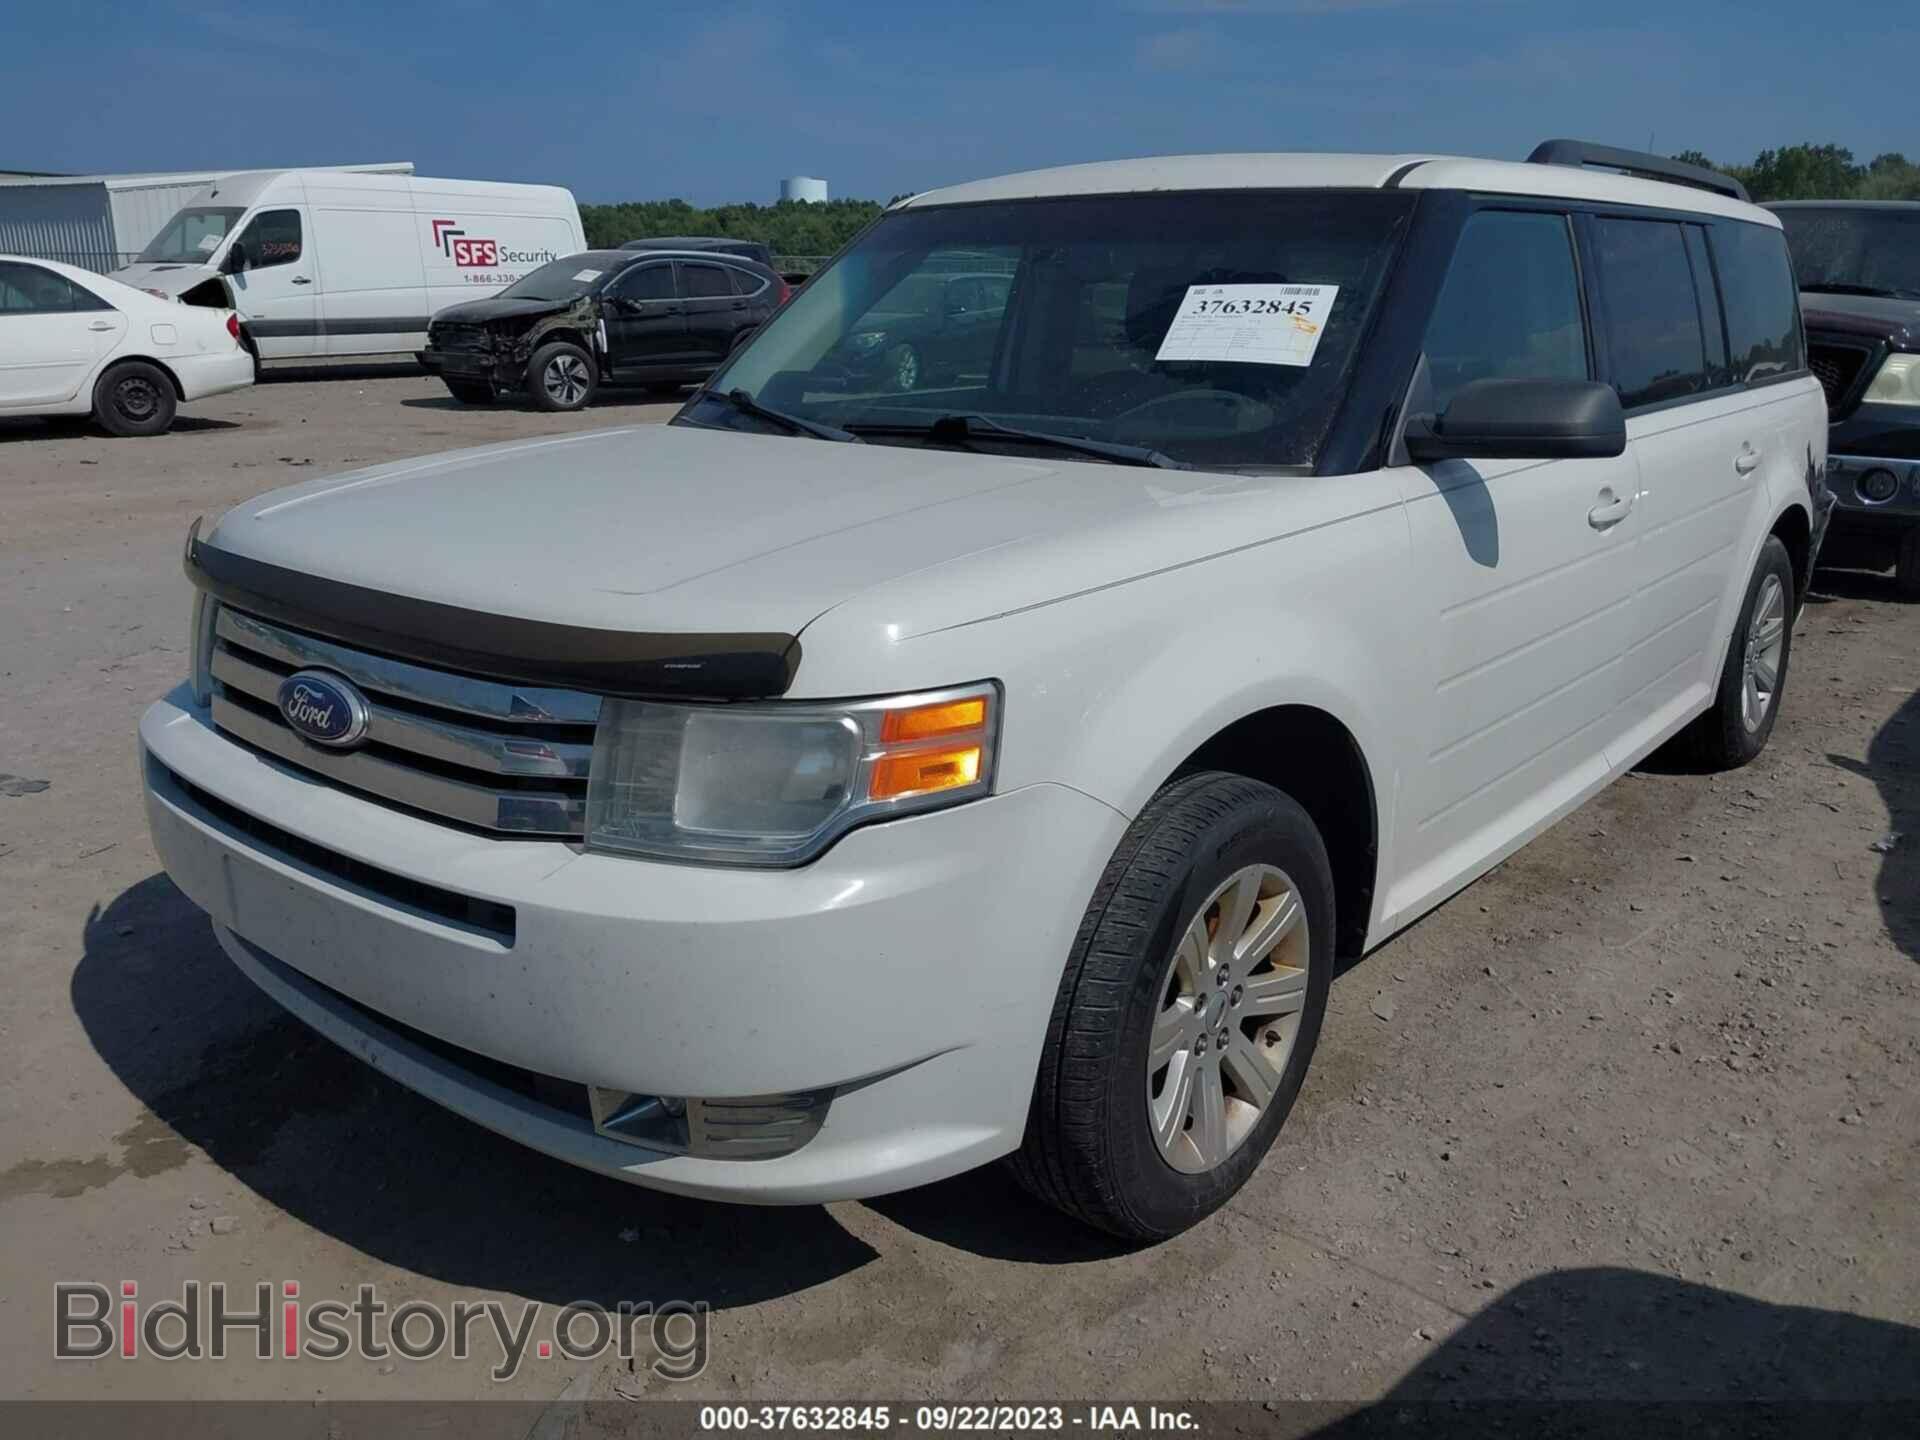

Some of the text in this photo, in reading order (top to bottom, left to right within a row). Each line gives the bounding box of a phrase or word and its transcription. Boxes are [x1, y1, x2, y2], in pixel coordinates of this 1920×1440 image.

[455, 242, 557, 264] SFS Security
[1192, 300, 1313, 315] 37632845
[288, 684, 334, 729] Ford
